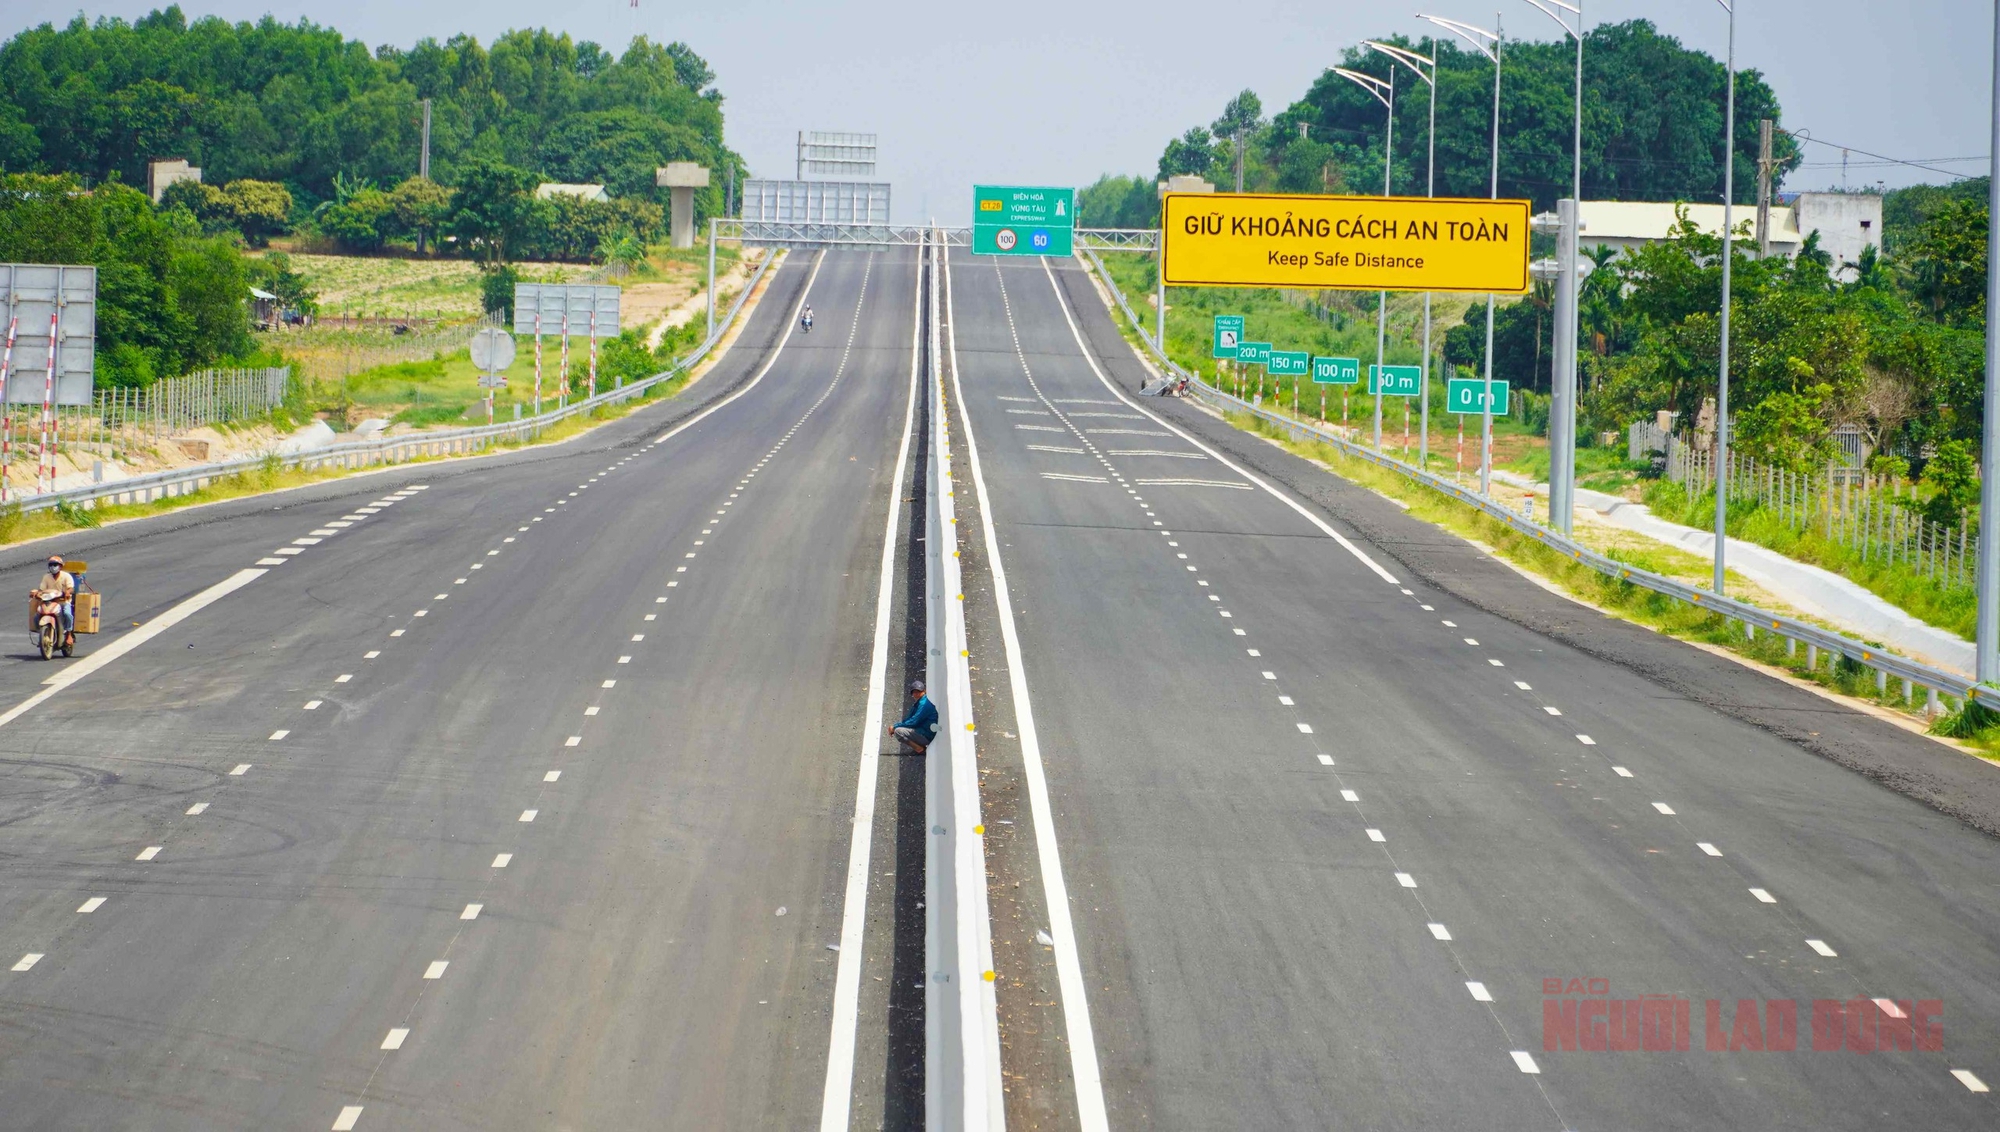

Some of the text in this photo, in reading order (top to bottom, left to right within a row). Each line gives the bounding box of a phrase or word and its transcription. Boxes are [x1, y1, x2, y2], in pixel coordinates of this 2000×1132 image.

[1013, 193, 1029, 201] BIÊN
[1032, 205, 1046, 213] TÀU
[1184, 211, 1508, 242] GIỮ KHOẢNG CÁCH AN TOÀN
[1000, 236, 1014, 244] 100
[1034, 235, 1047, 246] 60
[1268, 250, 1424, 269] Keep Safe Distance
[1240, 347, 1256, 357] 200
[1272, 357, 1289, 368] 150
[1318, 364, 1355, 377] 100 m
[1399, 378, 1413, 388] m
[1460, 388, 1472, 404] 0
